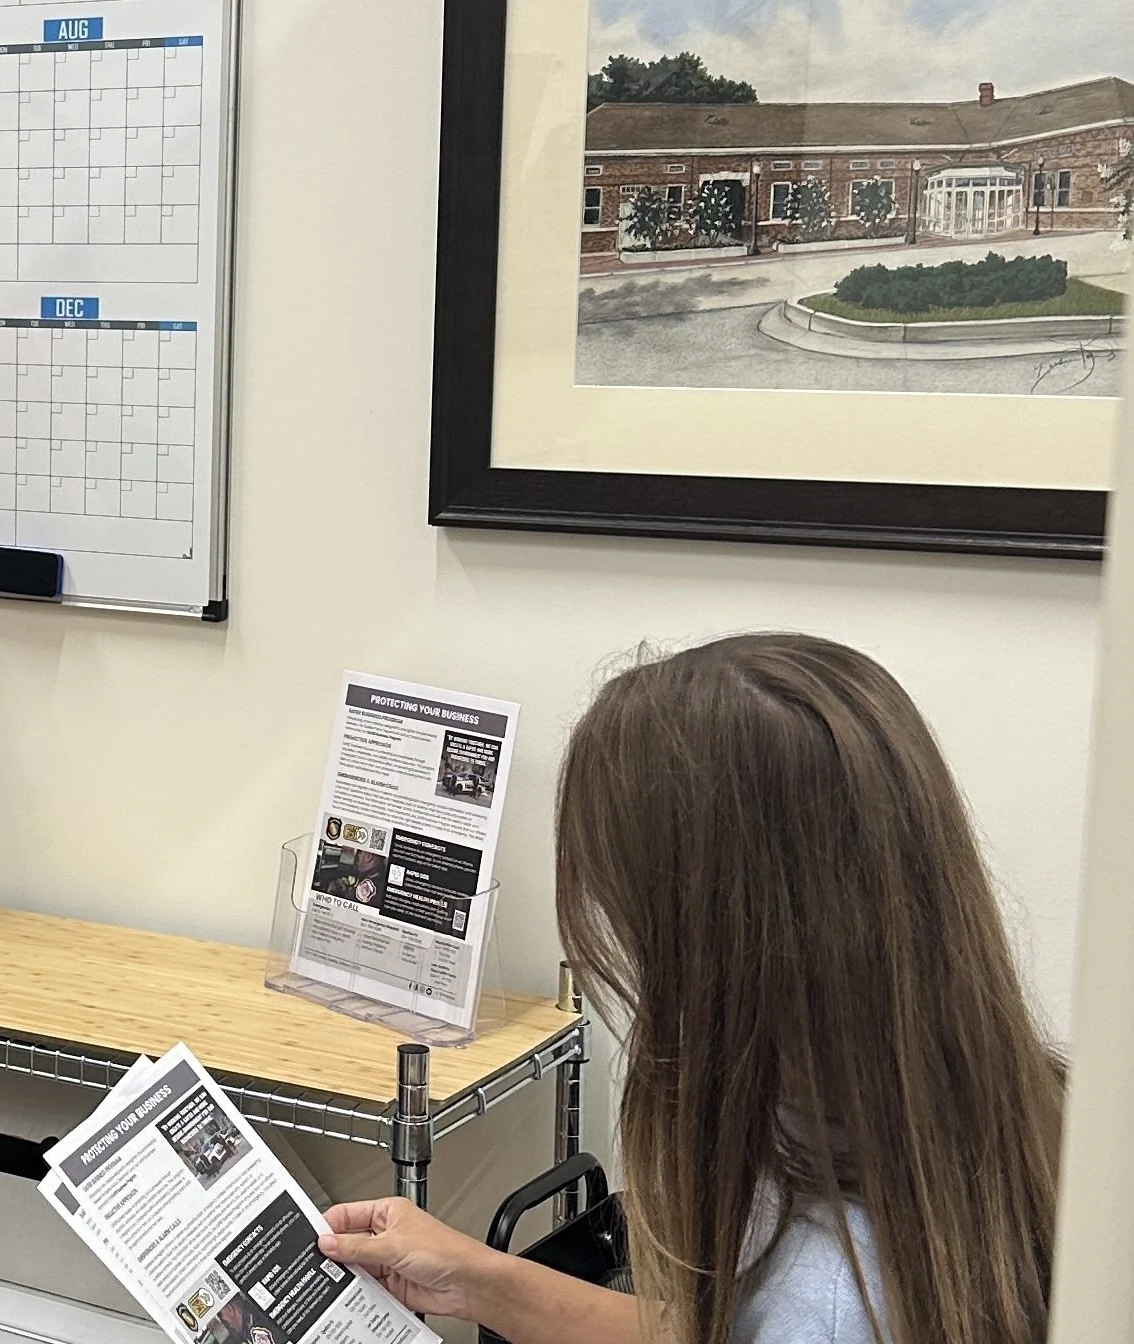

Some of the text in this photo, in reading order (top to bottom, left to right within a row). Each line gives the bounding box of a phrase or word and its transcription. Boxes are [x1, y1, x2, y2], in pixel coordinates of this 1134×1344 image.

[58, 20, 88, 39] AUG
[55, 299, 84, 317] DEC
[370, 695, 418, 713] PROTECTING
[420, 704, 441, 717] YOUR
[441, 710, 479, 725] BUSINESS
[316, 893, 359, 912] WHO TO CALL
[80, 1129, 119, 1166] PROTECTING
[115, 1112, 139, 1135] YOUR
[134, 1084, 172, 1119] BUSINESS
